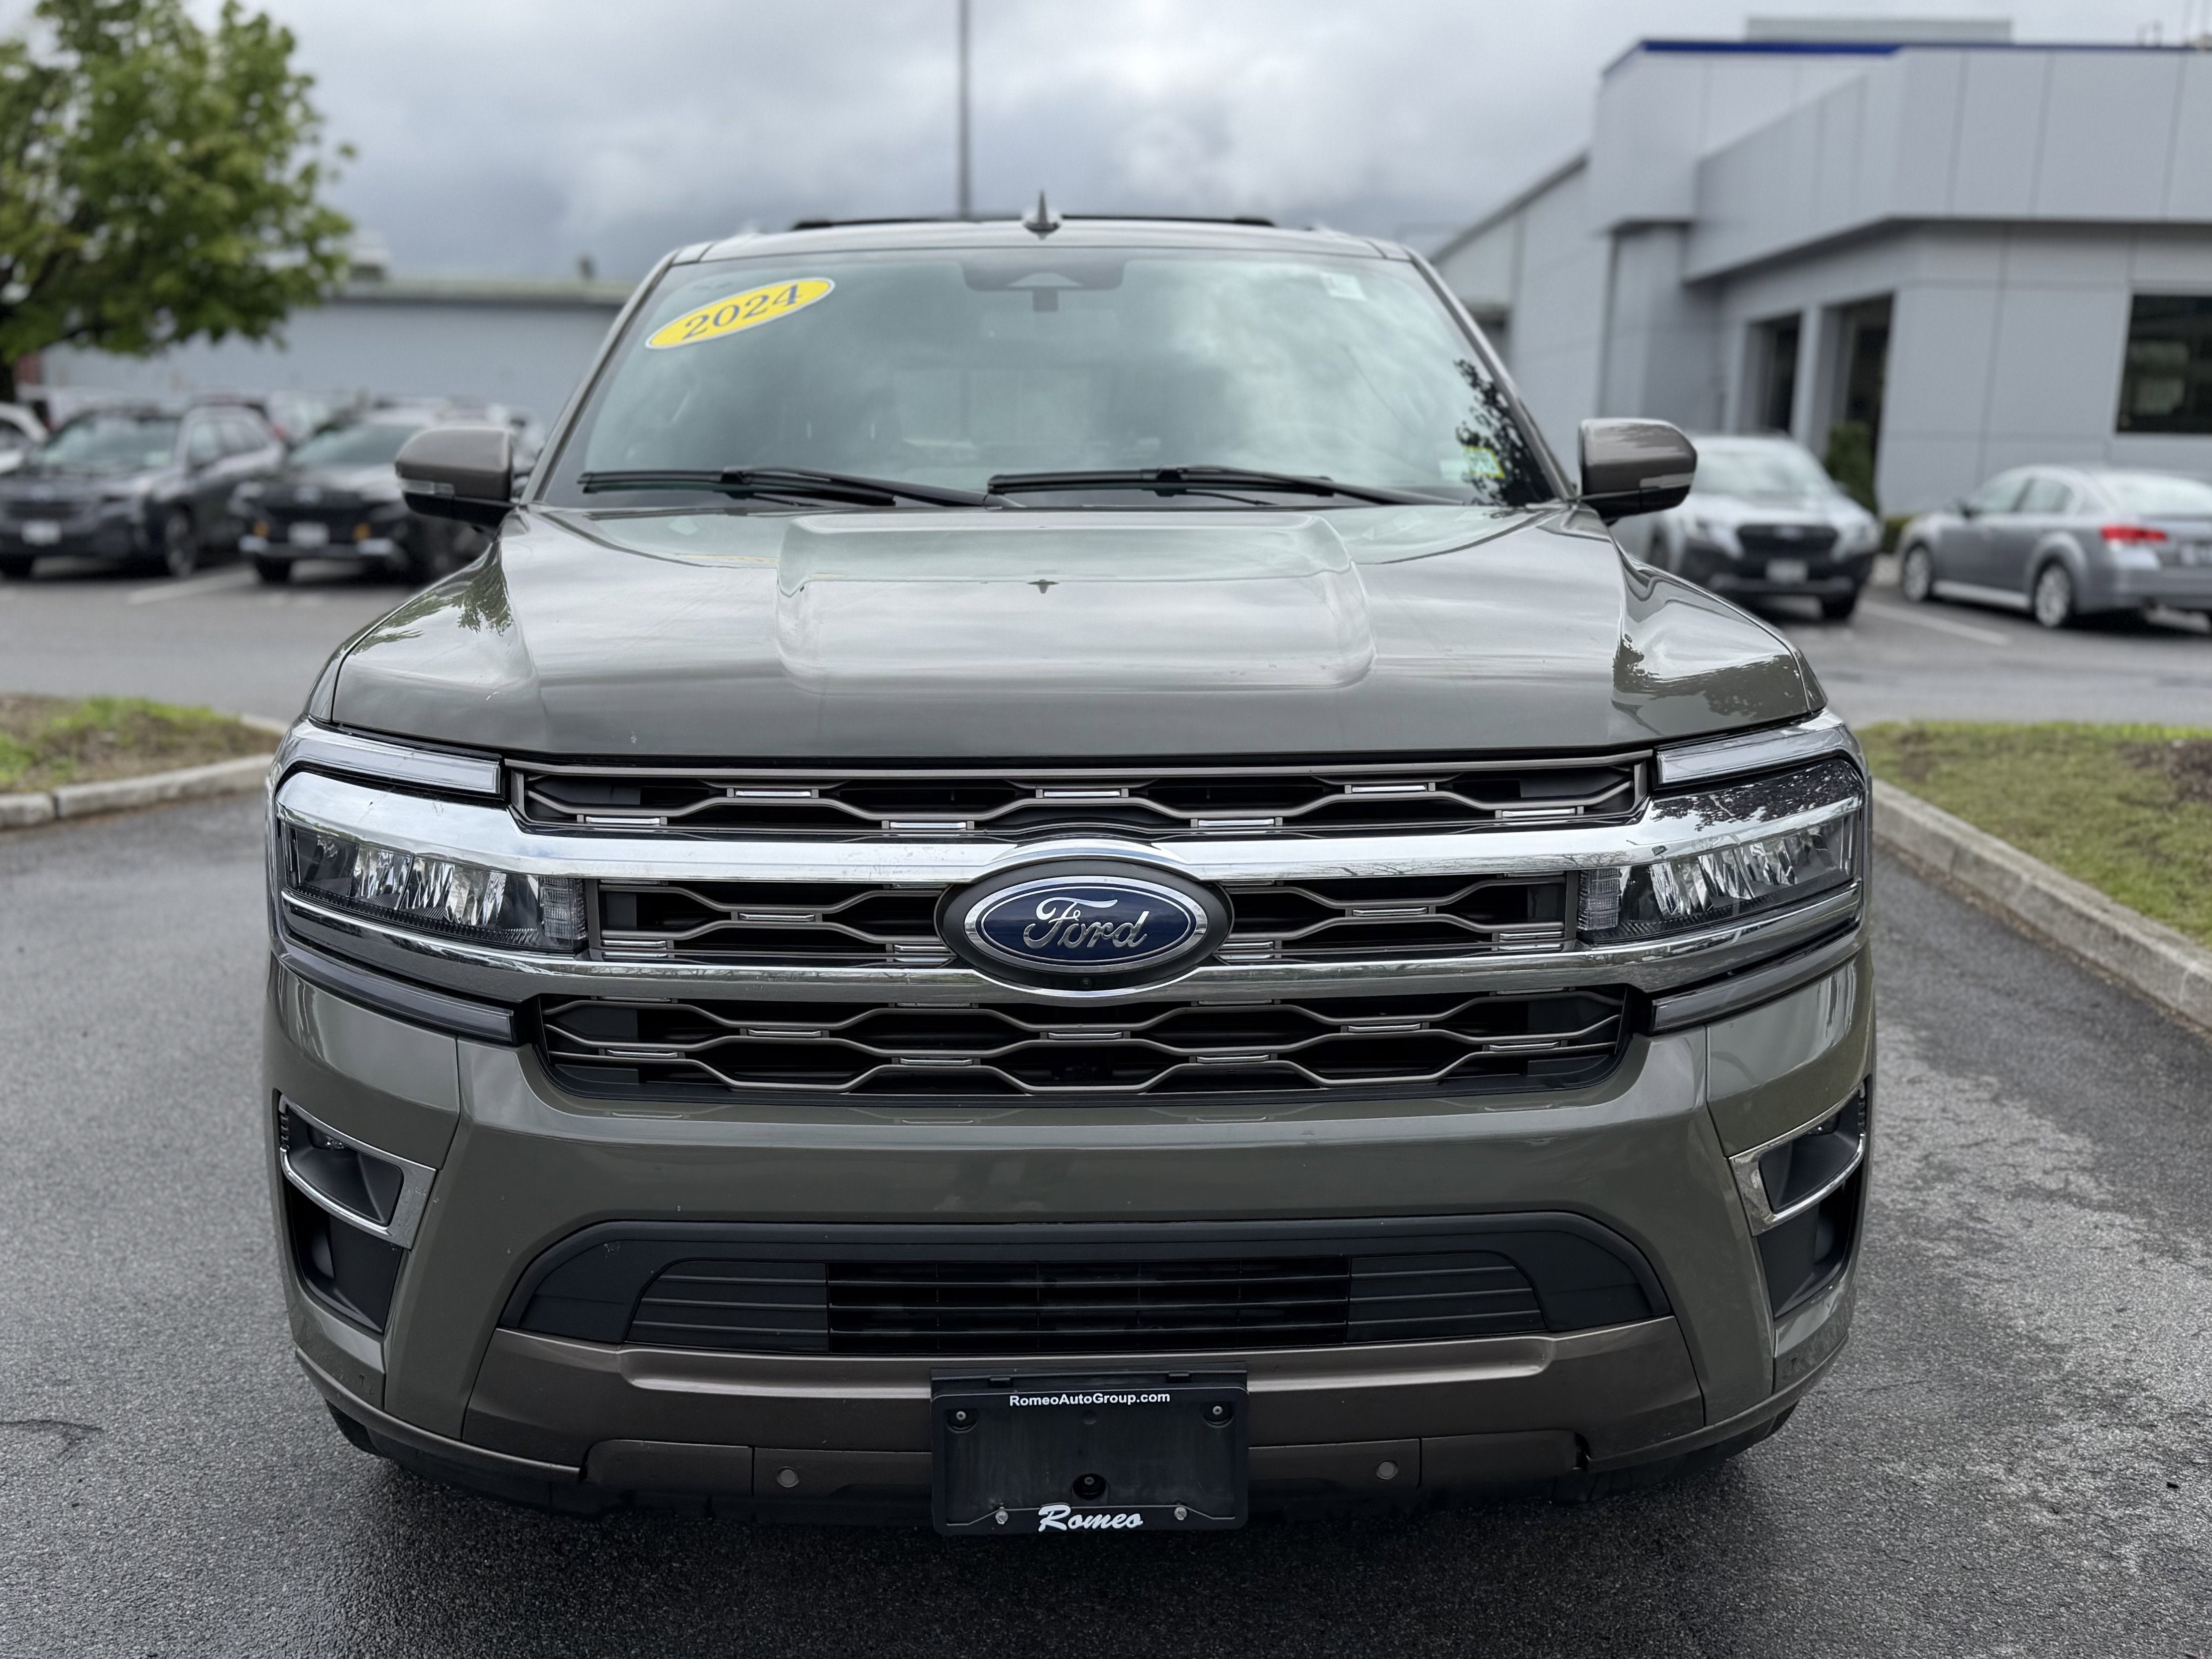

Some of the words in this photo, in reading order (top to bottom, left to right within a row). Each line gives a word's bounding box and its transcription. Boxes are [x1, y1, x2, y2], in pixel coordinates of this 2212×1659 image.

[682, 284, 802, 340] 2024
[1023, 897, 1150, 948] Ford
[1010, 1393, 1170, 1406] RomeoAutoGroup.com
[1038, 1504, 1143, 1532] Romeo
